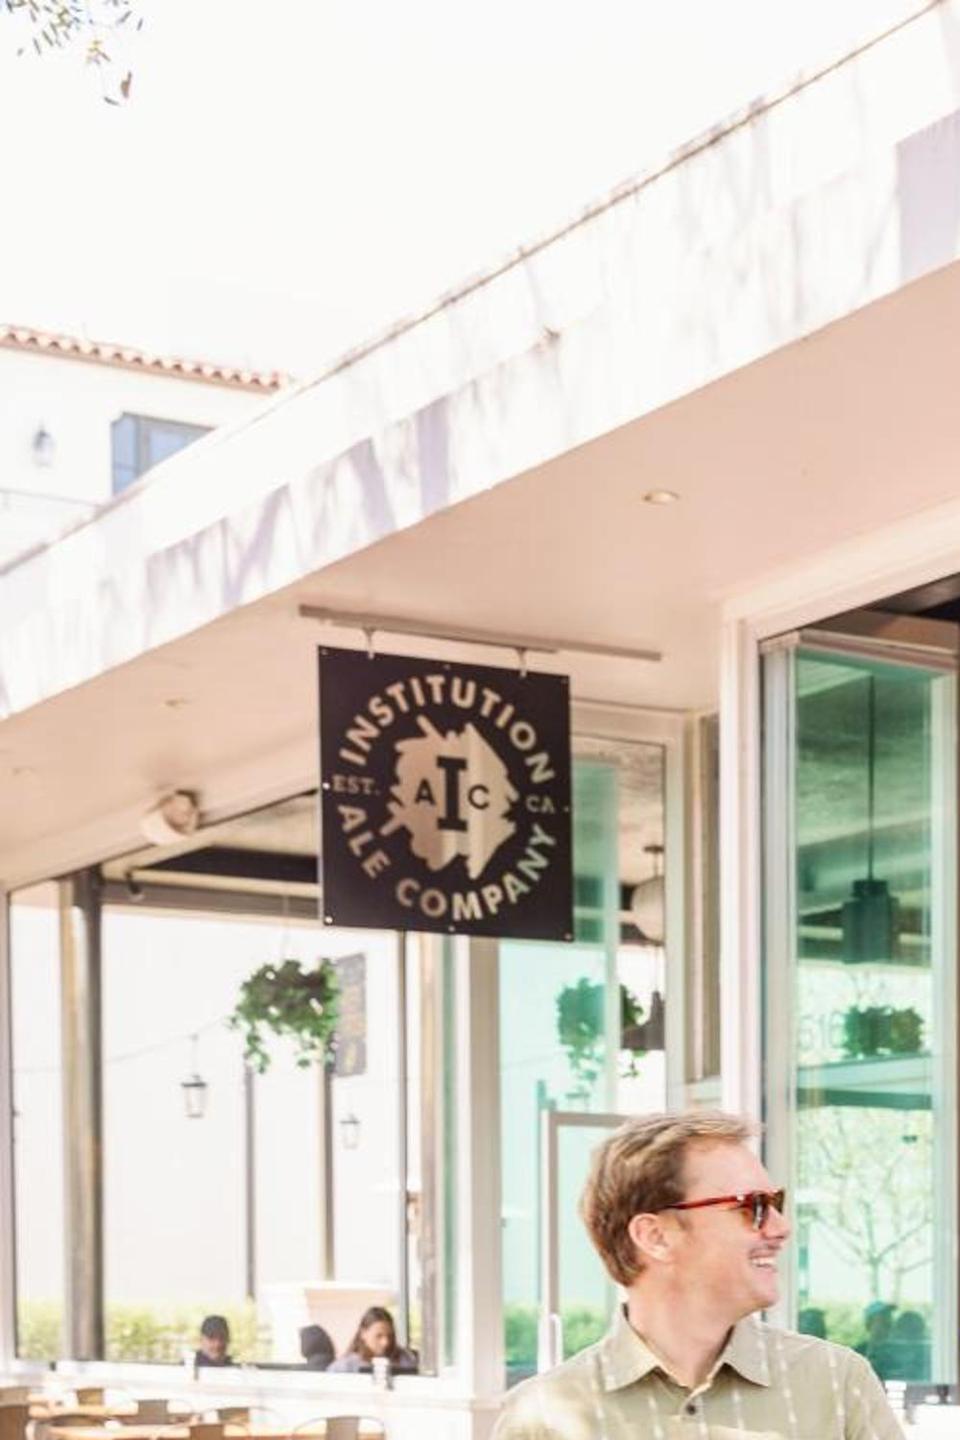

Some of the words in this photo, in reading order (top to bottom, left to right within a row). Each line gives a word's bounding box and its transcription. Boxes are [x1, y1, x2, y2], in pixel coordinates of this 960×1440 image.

[339, 674, 555, 784] INSTITUTION
[337, 804, 391, 879] ALE
[395, 823, 556, 921] COMPANY
